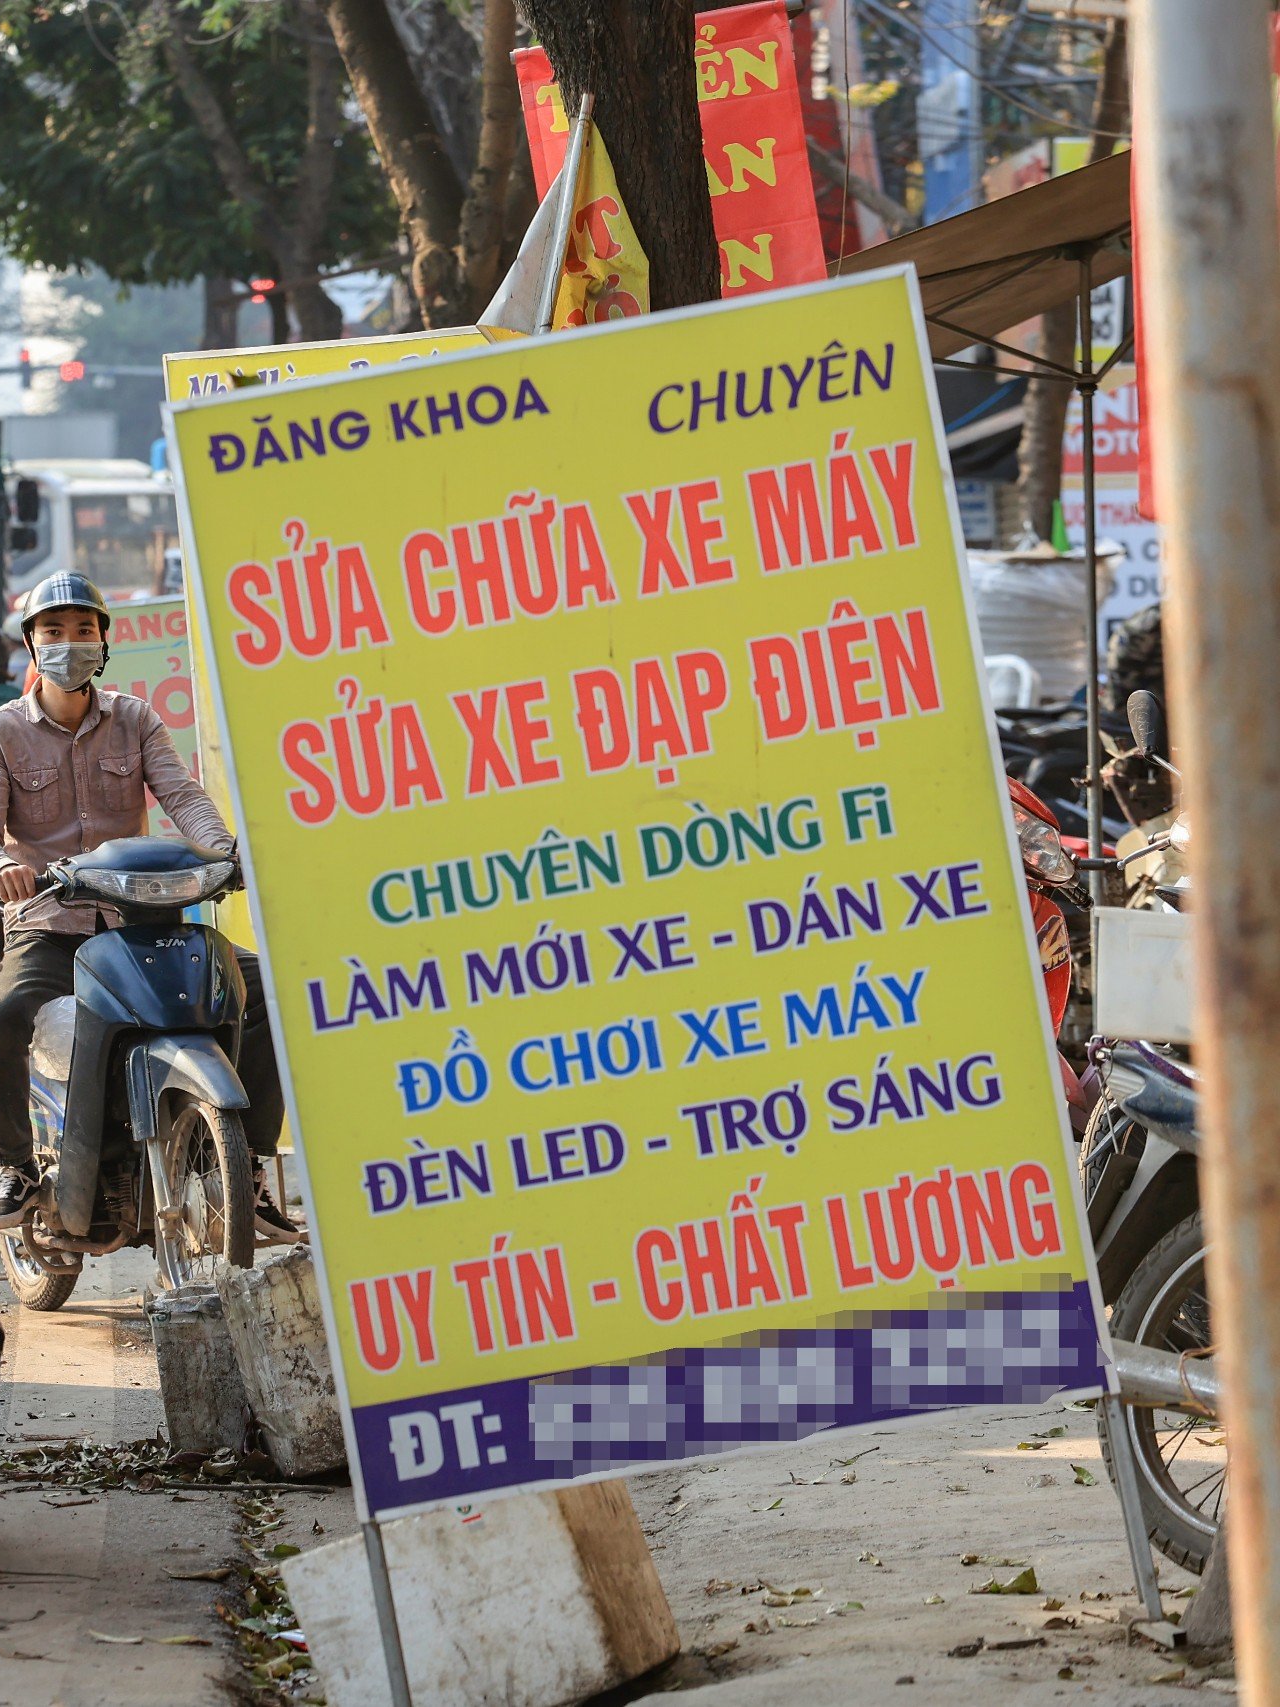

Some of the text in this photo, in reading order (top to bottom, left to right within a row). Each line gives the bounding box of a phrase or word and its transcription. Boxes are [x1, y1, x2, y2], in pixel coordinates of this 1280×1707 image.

[209, 378, 549, 473] ĐĂNG KHOA
[648, 343, 894, 434] CHUYÊN
[228, 431, 916, 667] SỬA CHỮA XE MÁY
[282, 600, 941, 825] SỬA XE ĐẠP ĐIỆN
[370, 786, 893, 925] CHUYÊN DÒNG Fi
[308, 958, 447, 1031] LÀM
[465, 932, 591, 1003] MỚI
[607, 915, 695, 978] XE
[747, 876, 883, 953] DÁN
[900, 862, 988, 926] XE
[398, 964, 925, 1114] ĐỒ CHƠI XE MÁY
[363, 1144, 492, 1214] ĐÈN
[509, 1122, 625, 1188] LED
[681, 1083, 807, 1156] TRỢ
[826, 1054, 1002, 1131] SÁNG
[350, 1270, 436, 1372] UY
[453, 1235, 575, 1352] TÍN
[635, 1176, 809, 1322] CHẤT
[826, 1163, 1062, 1290] LƯỢNG
[388, 1398, 508, 1483] ĐT:
